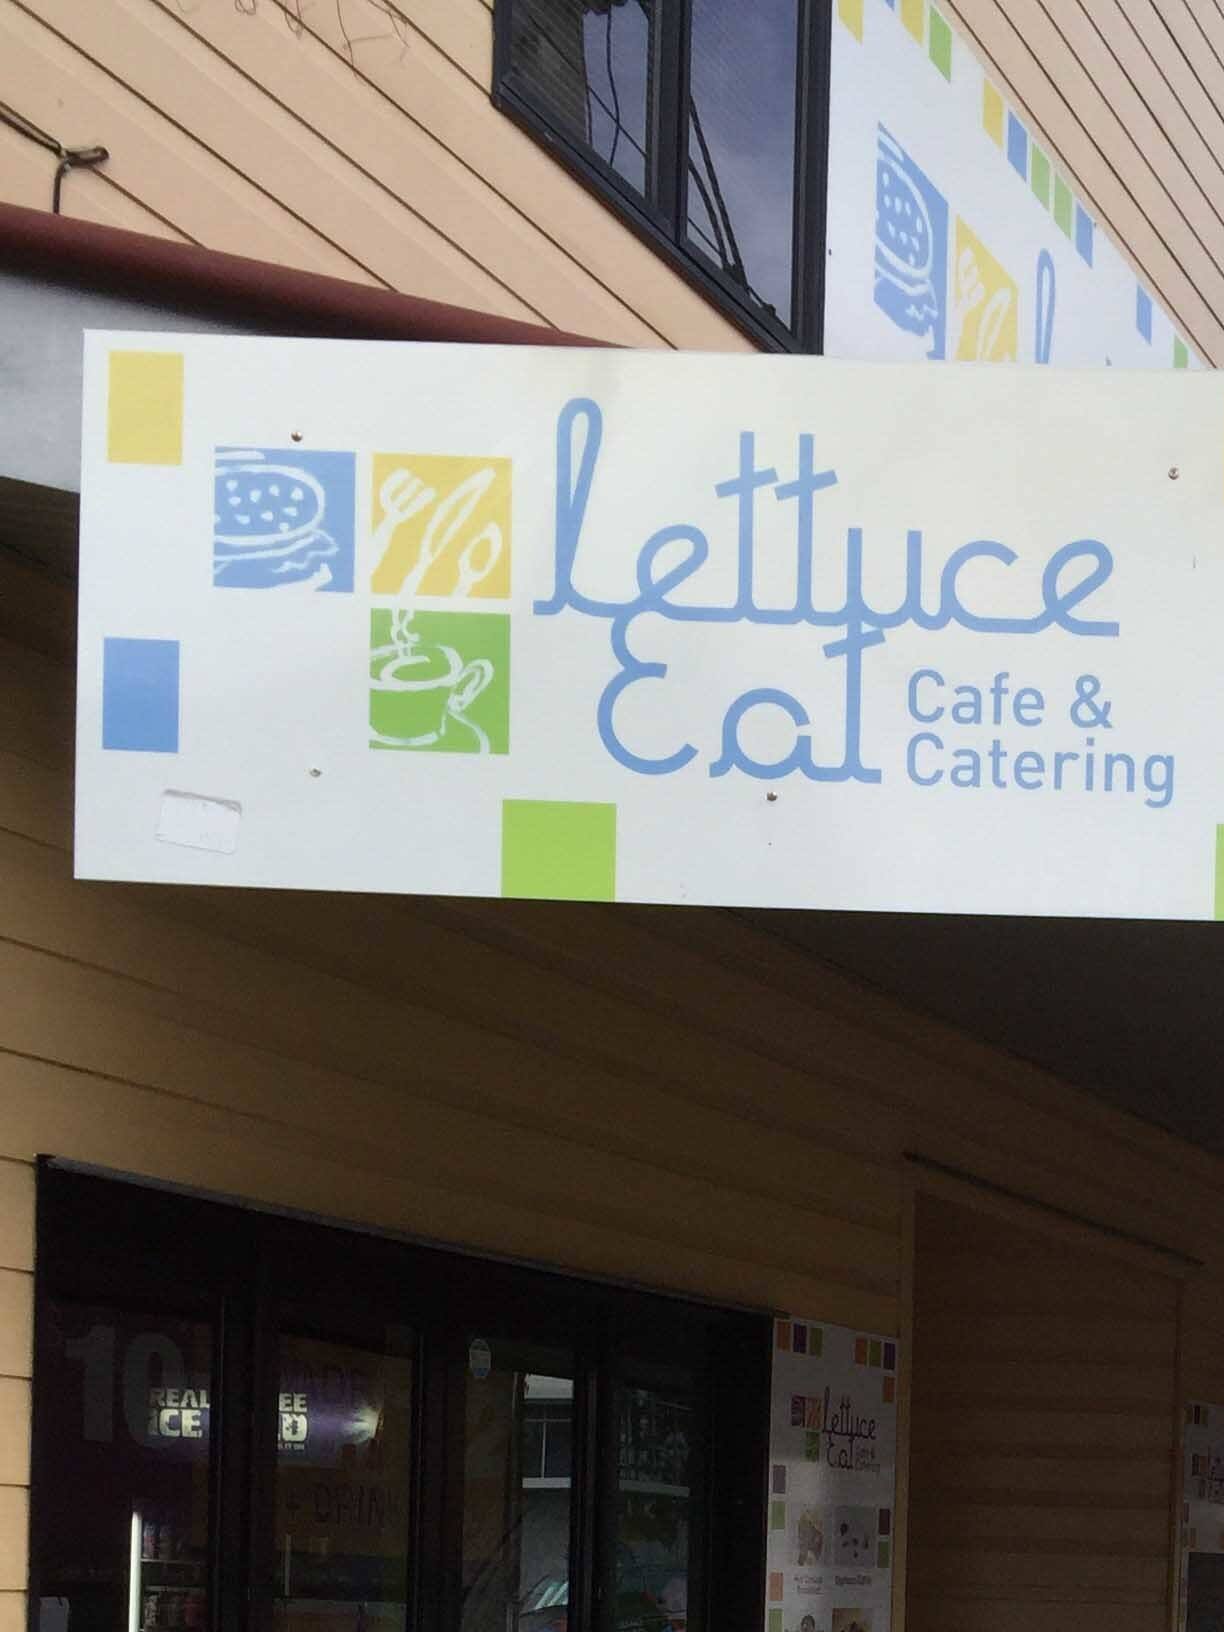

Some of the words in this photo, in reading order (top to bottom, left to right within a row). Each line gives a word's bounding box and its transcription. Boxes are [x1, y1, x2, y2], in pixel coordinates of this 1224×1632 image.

[598, 612, 885, 785] Eat
[907, 667, 1045, 726] Cafe
[1070, 676, 1112, 728] &
[907, 732, 1176, 808] Catering
[148, 1388, 210, 1409] REAL
